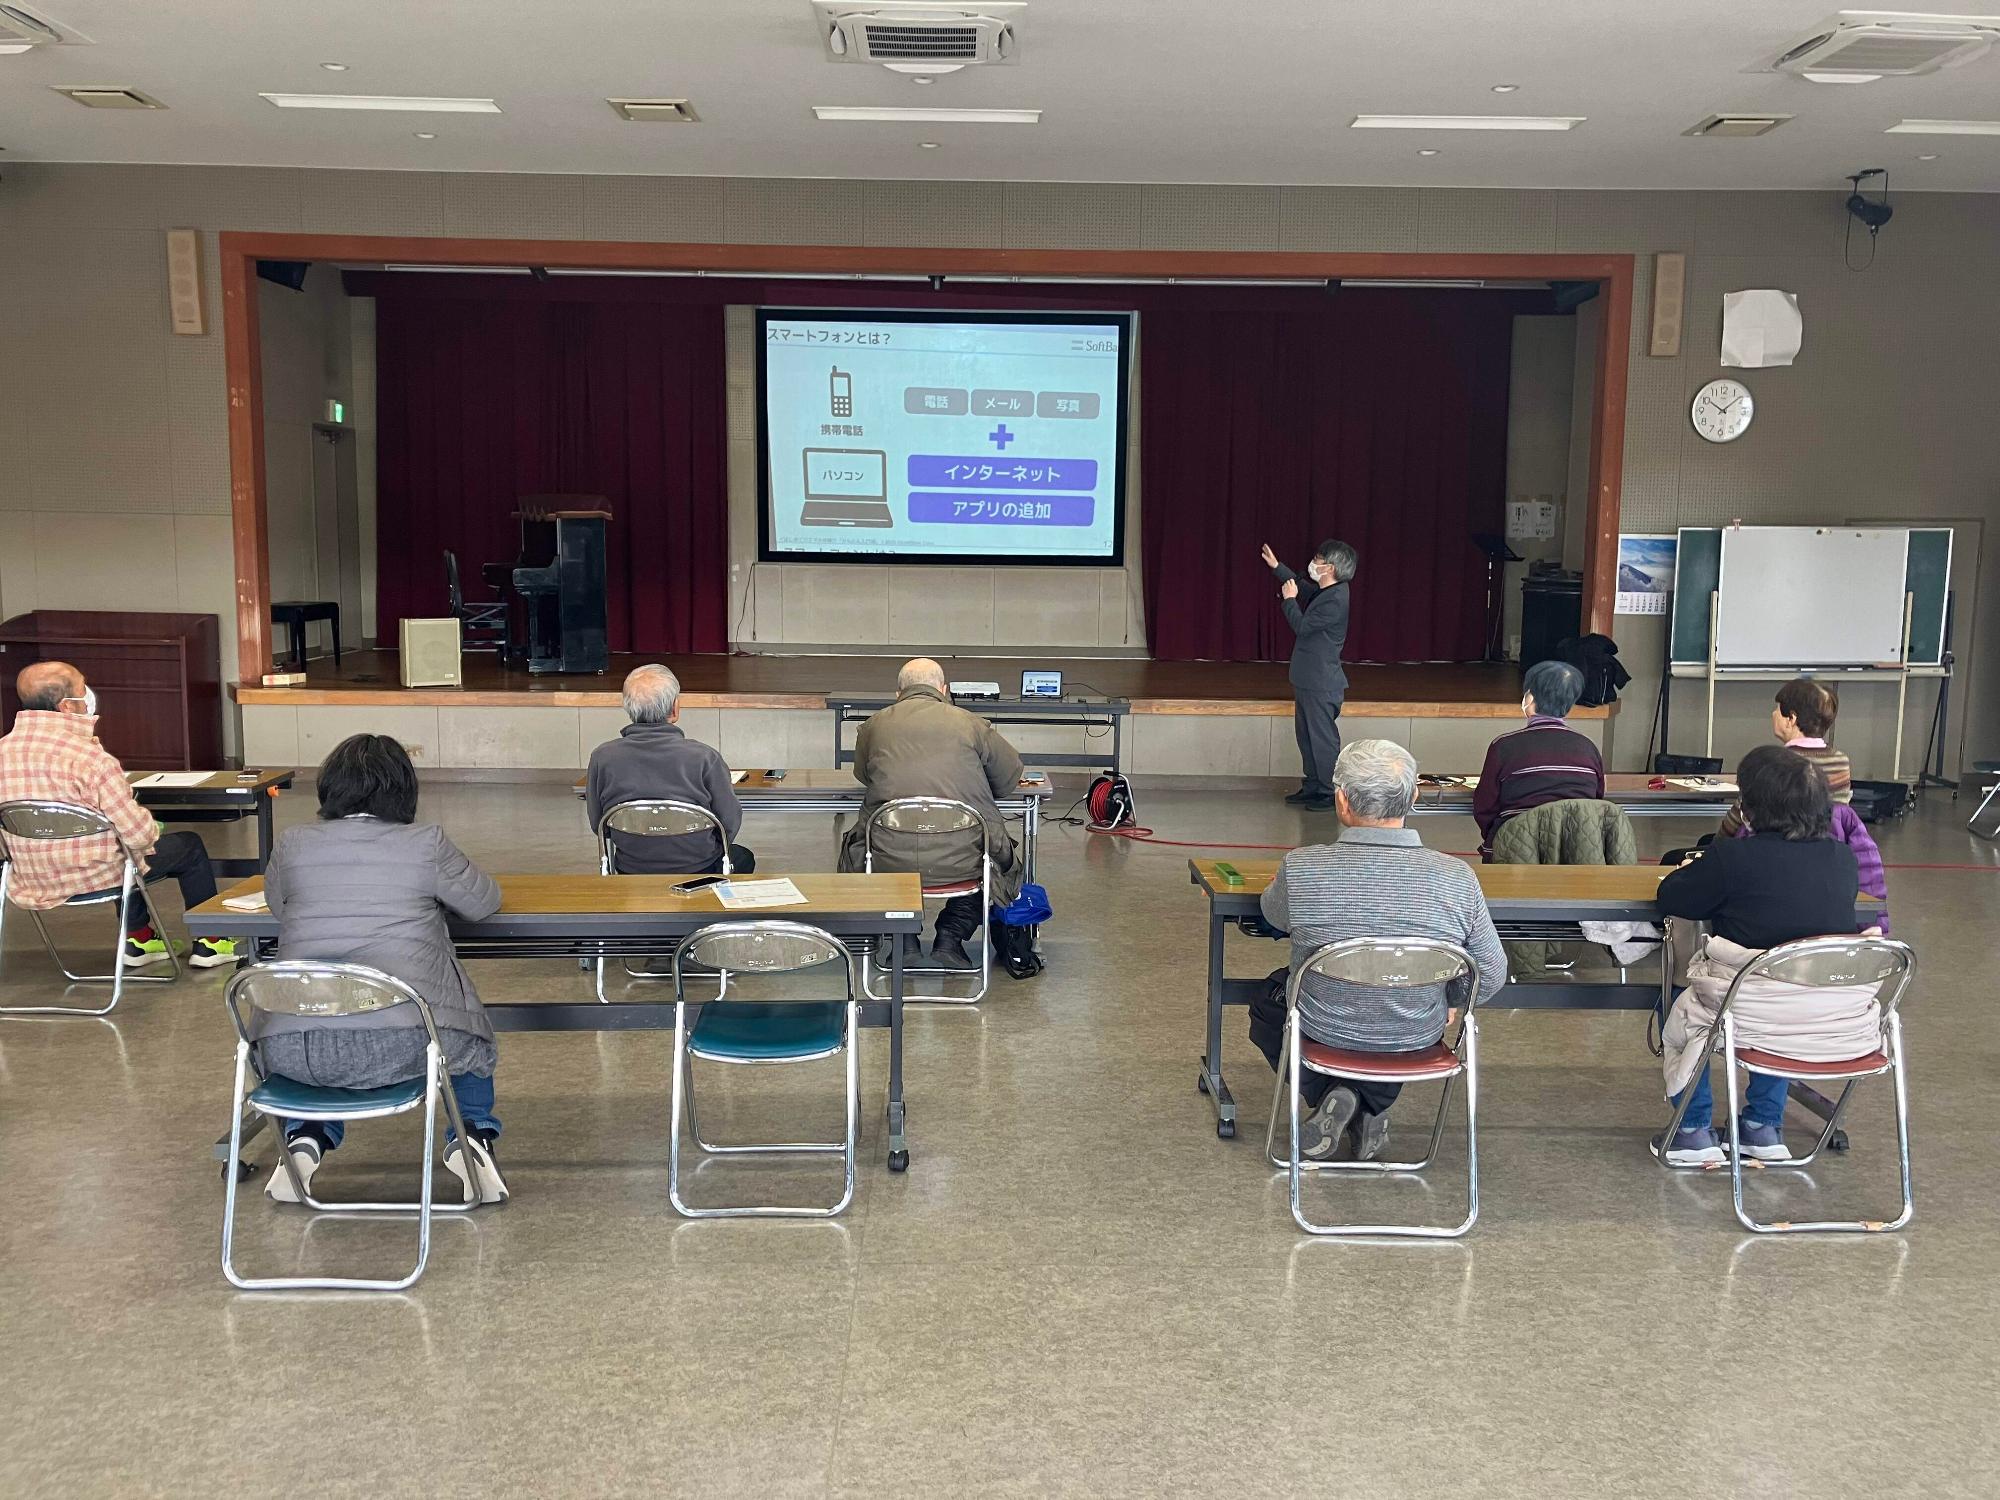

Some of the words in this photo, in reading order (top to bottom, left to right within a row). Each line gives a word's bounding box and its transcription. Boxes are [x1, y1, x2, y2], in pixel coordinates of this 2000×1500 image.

[768, 328, 891, 345] スマートフォンとは？
[1721, 386, 1729, 395] 12
[924, 395, 949, 409] 電話
[985, 397, 1021, 411] メール
[1055, 399, 1080, 413] 写真
[1702, 396, 1711, 405] 10
[820, 424, 864, 437] 携帯電話
[822, 470, 864, 481] パソコン
[944, 464, 1061, 482] インターネット
[952, 501, 1051, 519] アプリの追加
